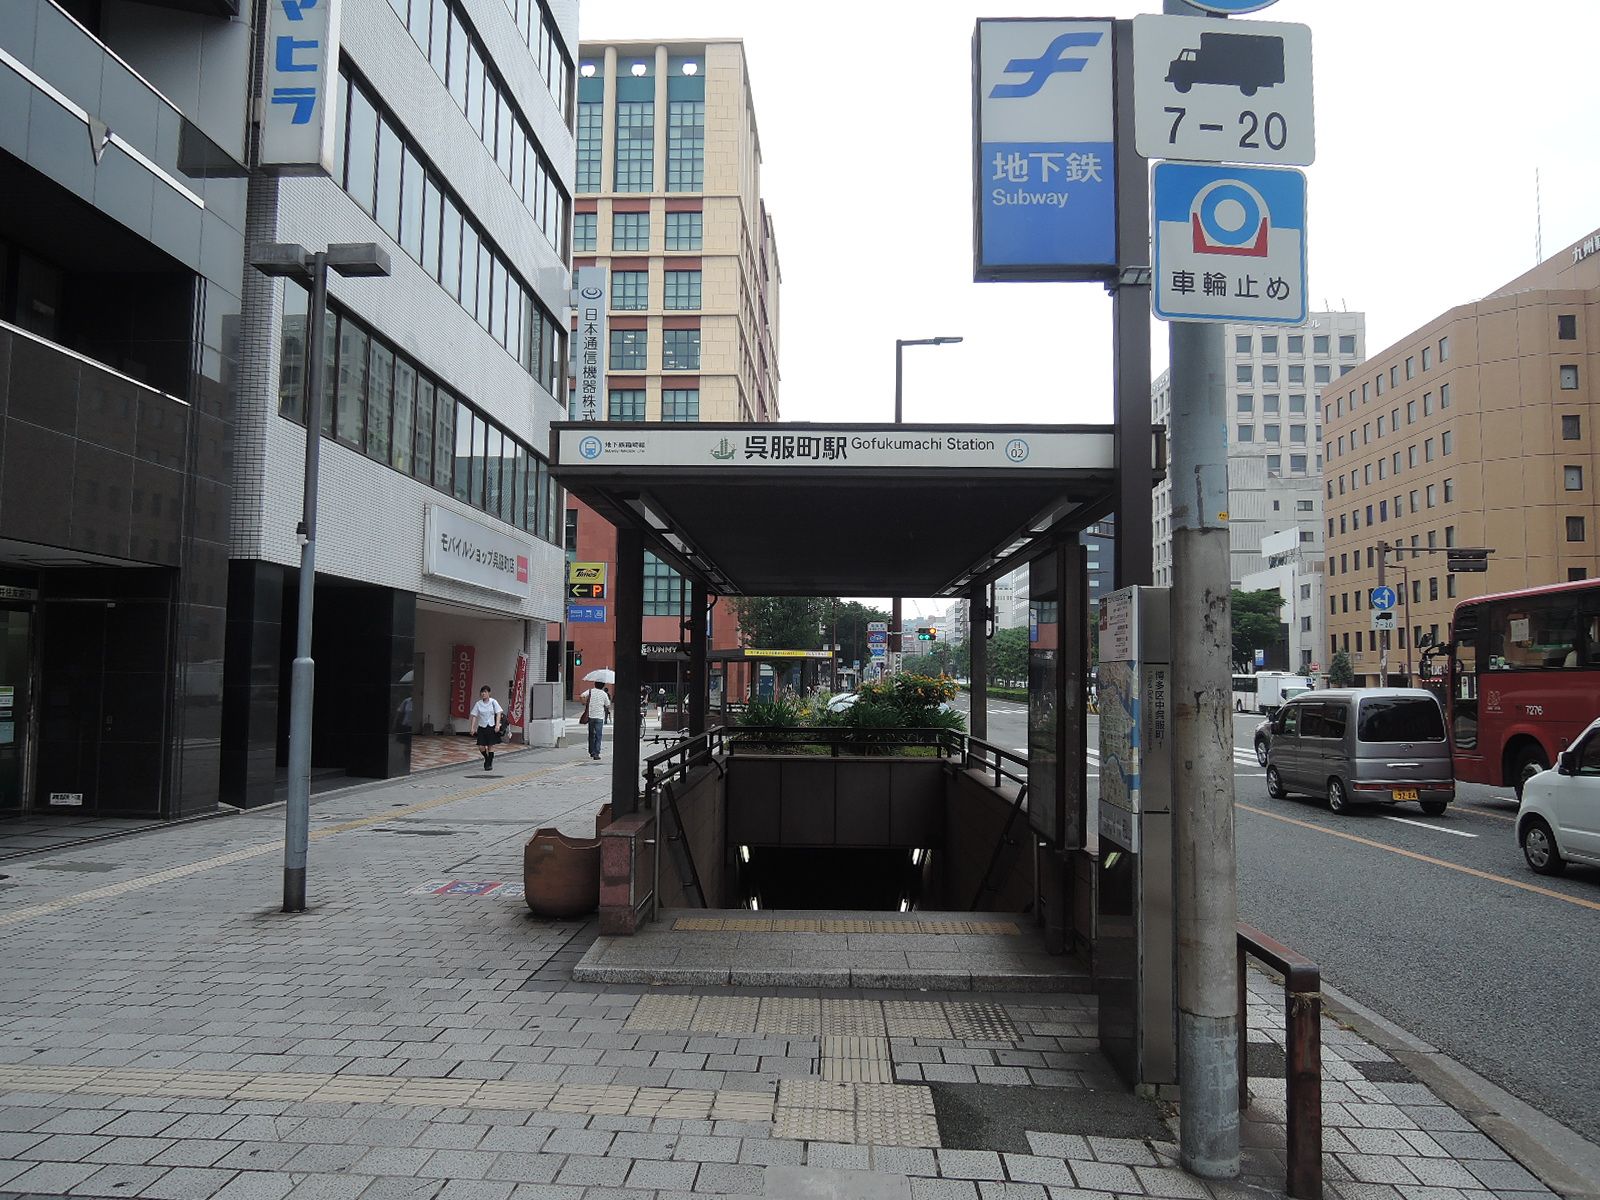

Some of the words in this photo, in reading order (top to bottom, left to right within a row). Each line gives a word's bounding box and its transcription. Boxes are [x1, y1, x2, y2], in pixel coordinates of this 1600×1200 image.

[992, 152, 1103, 183] 地下鉄
[992, 188, 1069, 208] Subway
[1171, 269, 1290, 301] 車輪止め
[581, 308, 598, 421] 日本通信機器株式
[744, 436, 848, 460] 呉服町駅
[851, 437, 942, 450] Gofukumachi
[947, 438, 994, 450] Station
[1011, 449, 1023, 458] 02
[575, 568, 600, 578] Times
[592, 585, 602, 597] P
[1525, 705, 1543, 715] 7276
